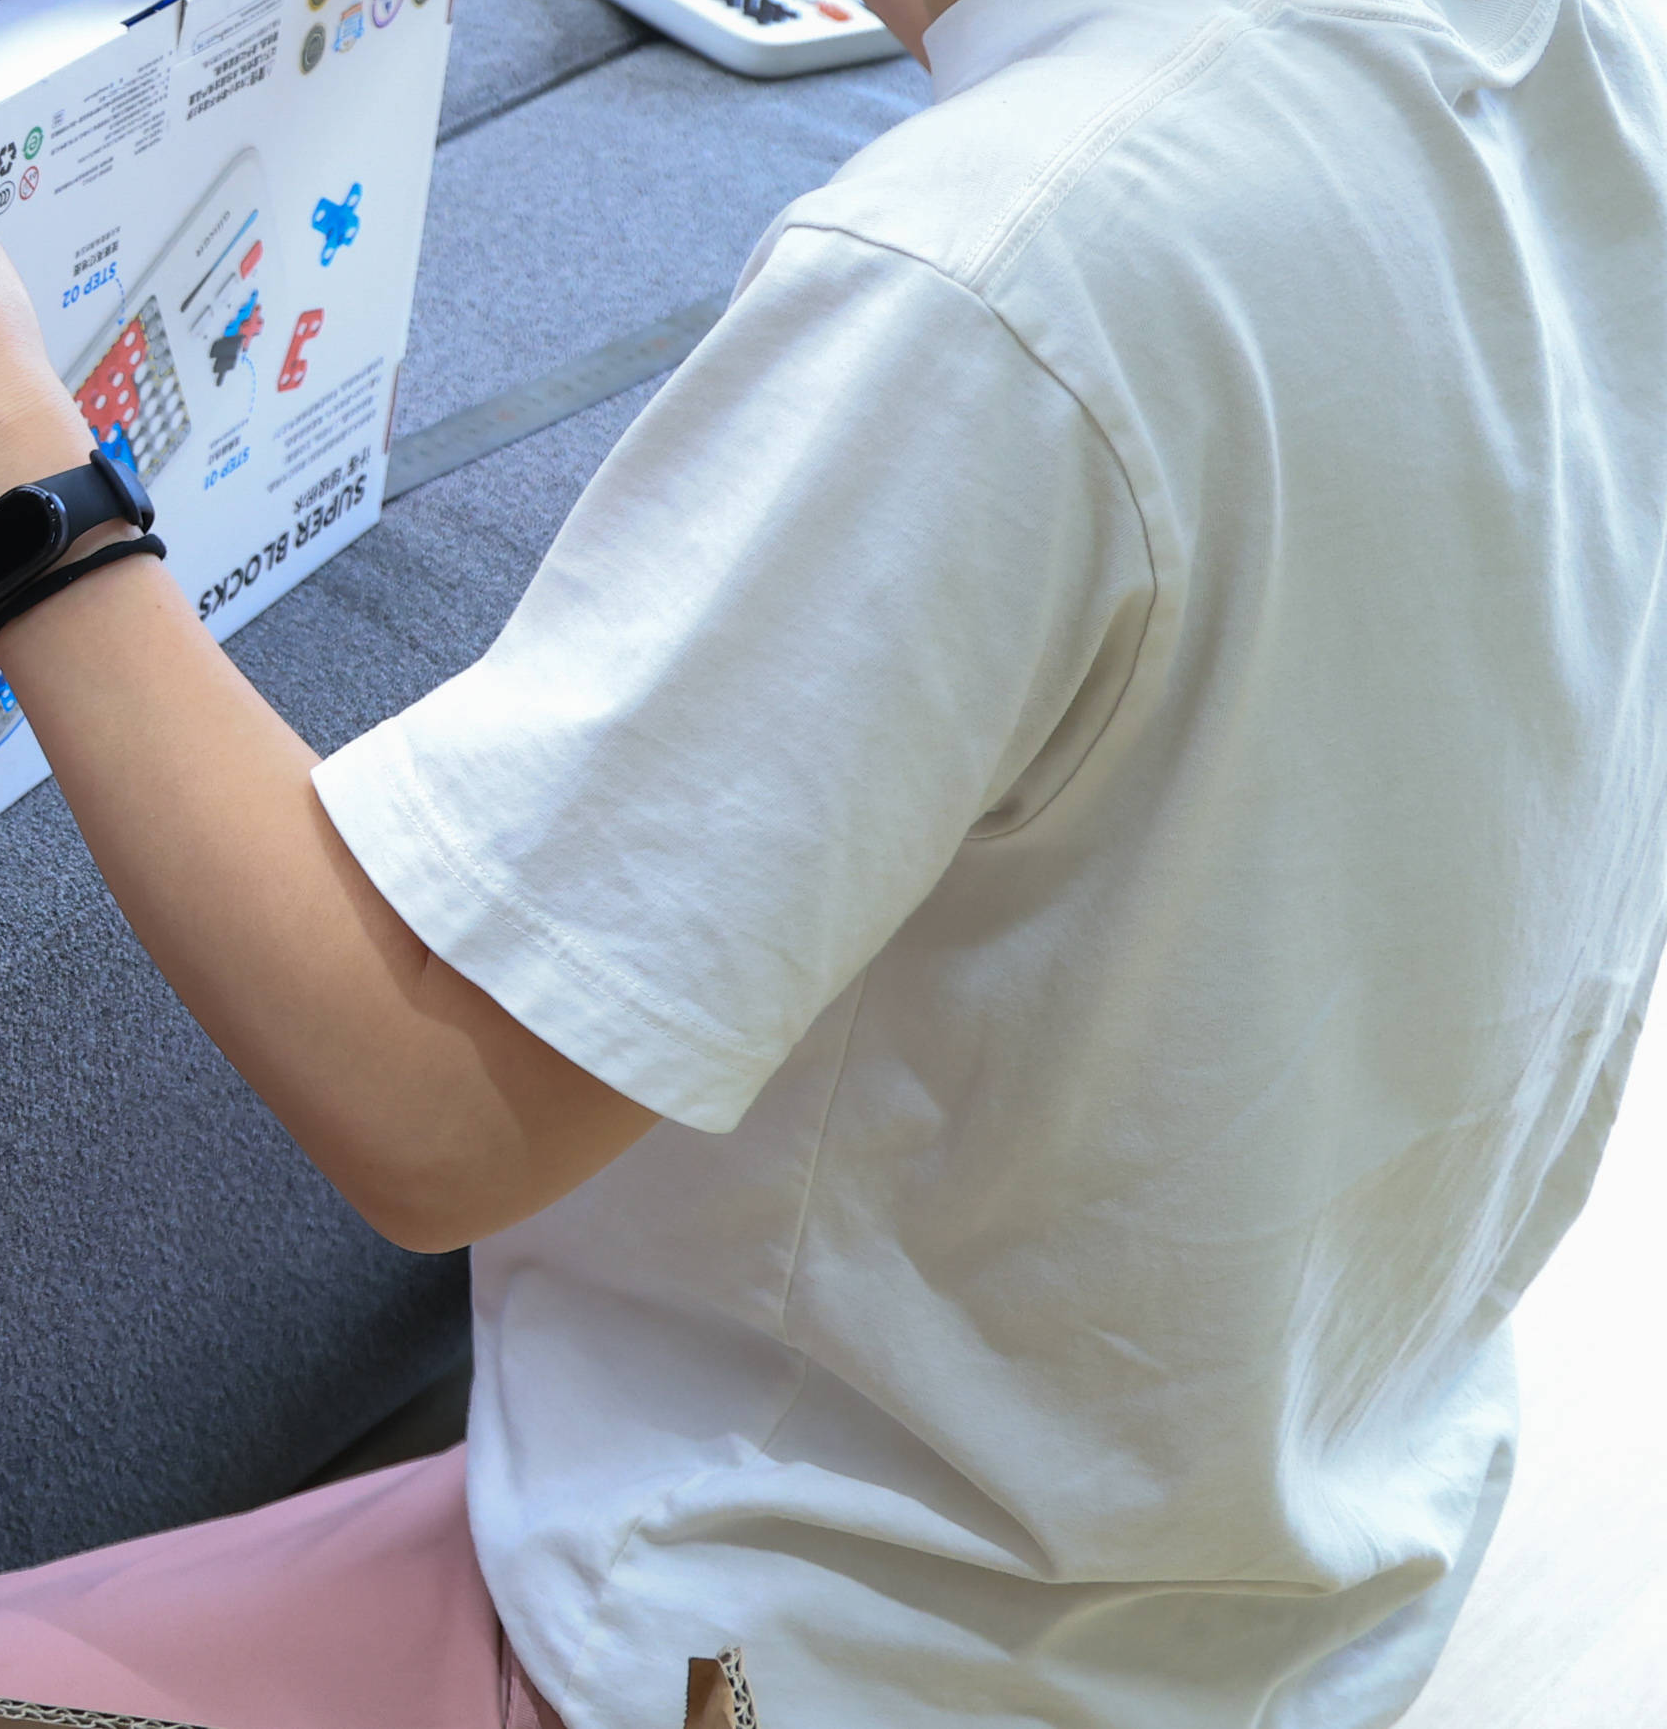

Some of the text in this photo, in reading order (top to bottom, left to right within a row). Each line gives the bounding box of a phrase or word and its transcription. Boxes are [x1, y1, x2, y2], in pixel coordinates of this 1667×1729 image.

[62, 261, 117, 309] STEP 02
[220, 446, 250, 478] STEP
[199, 474, 367, 621] SUPER BLOCKS
